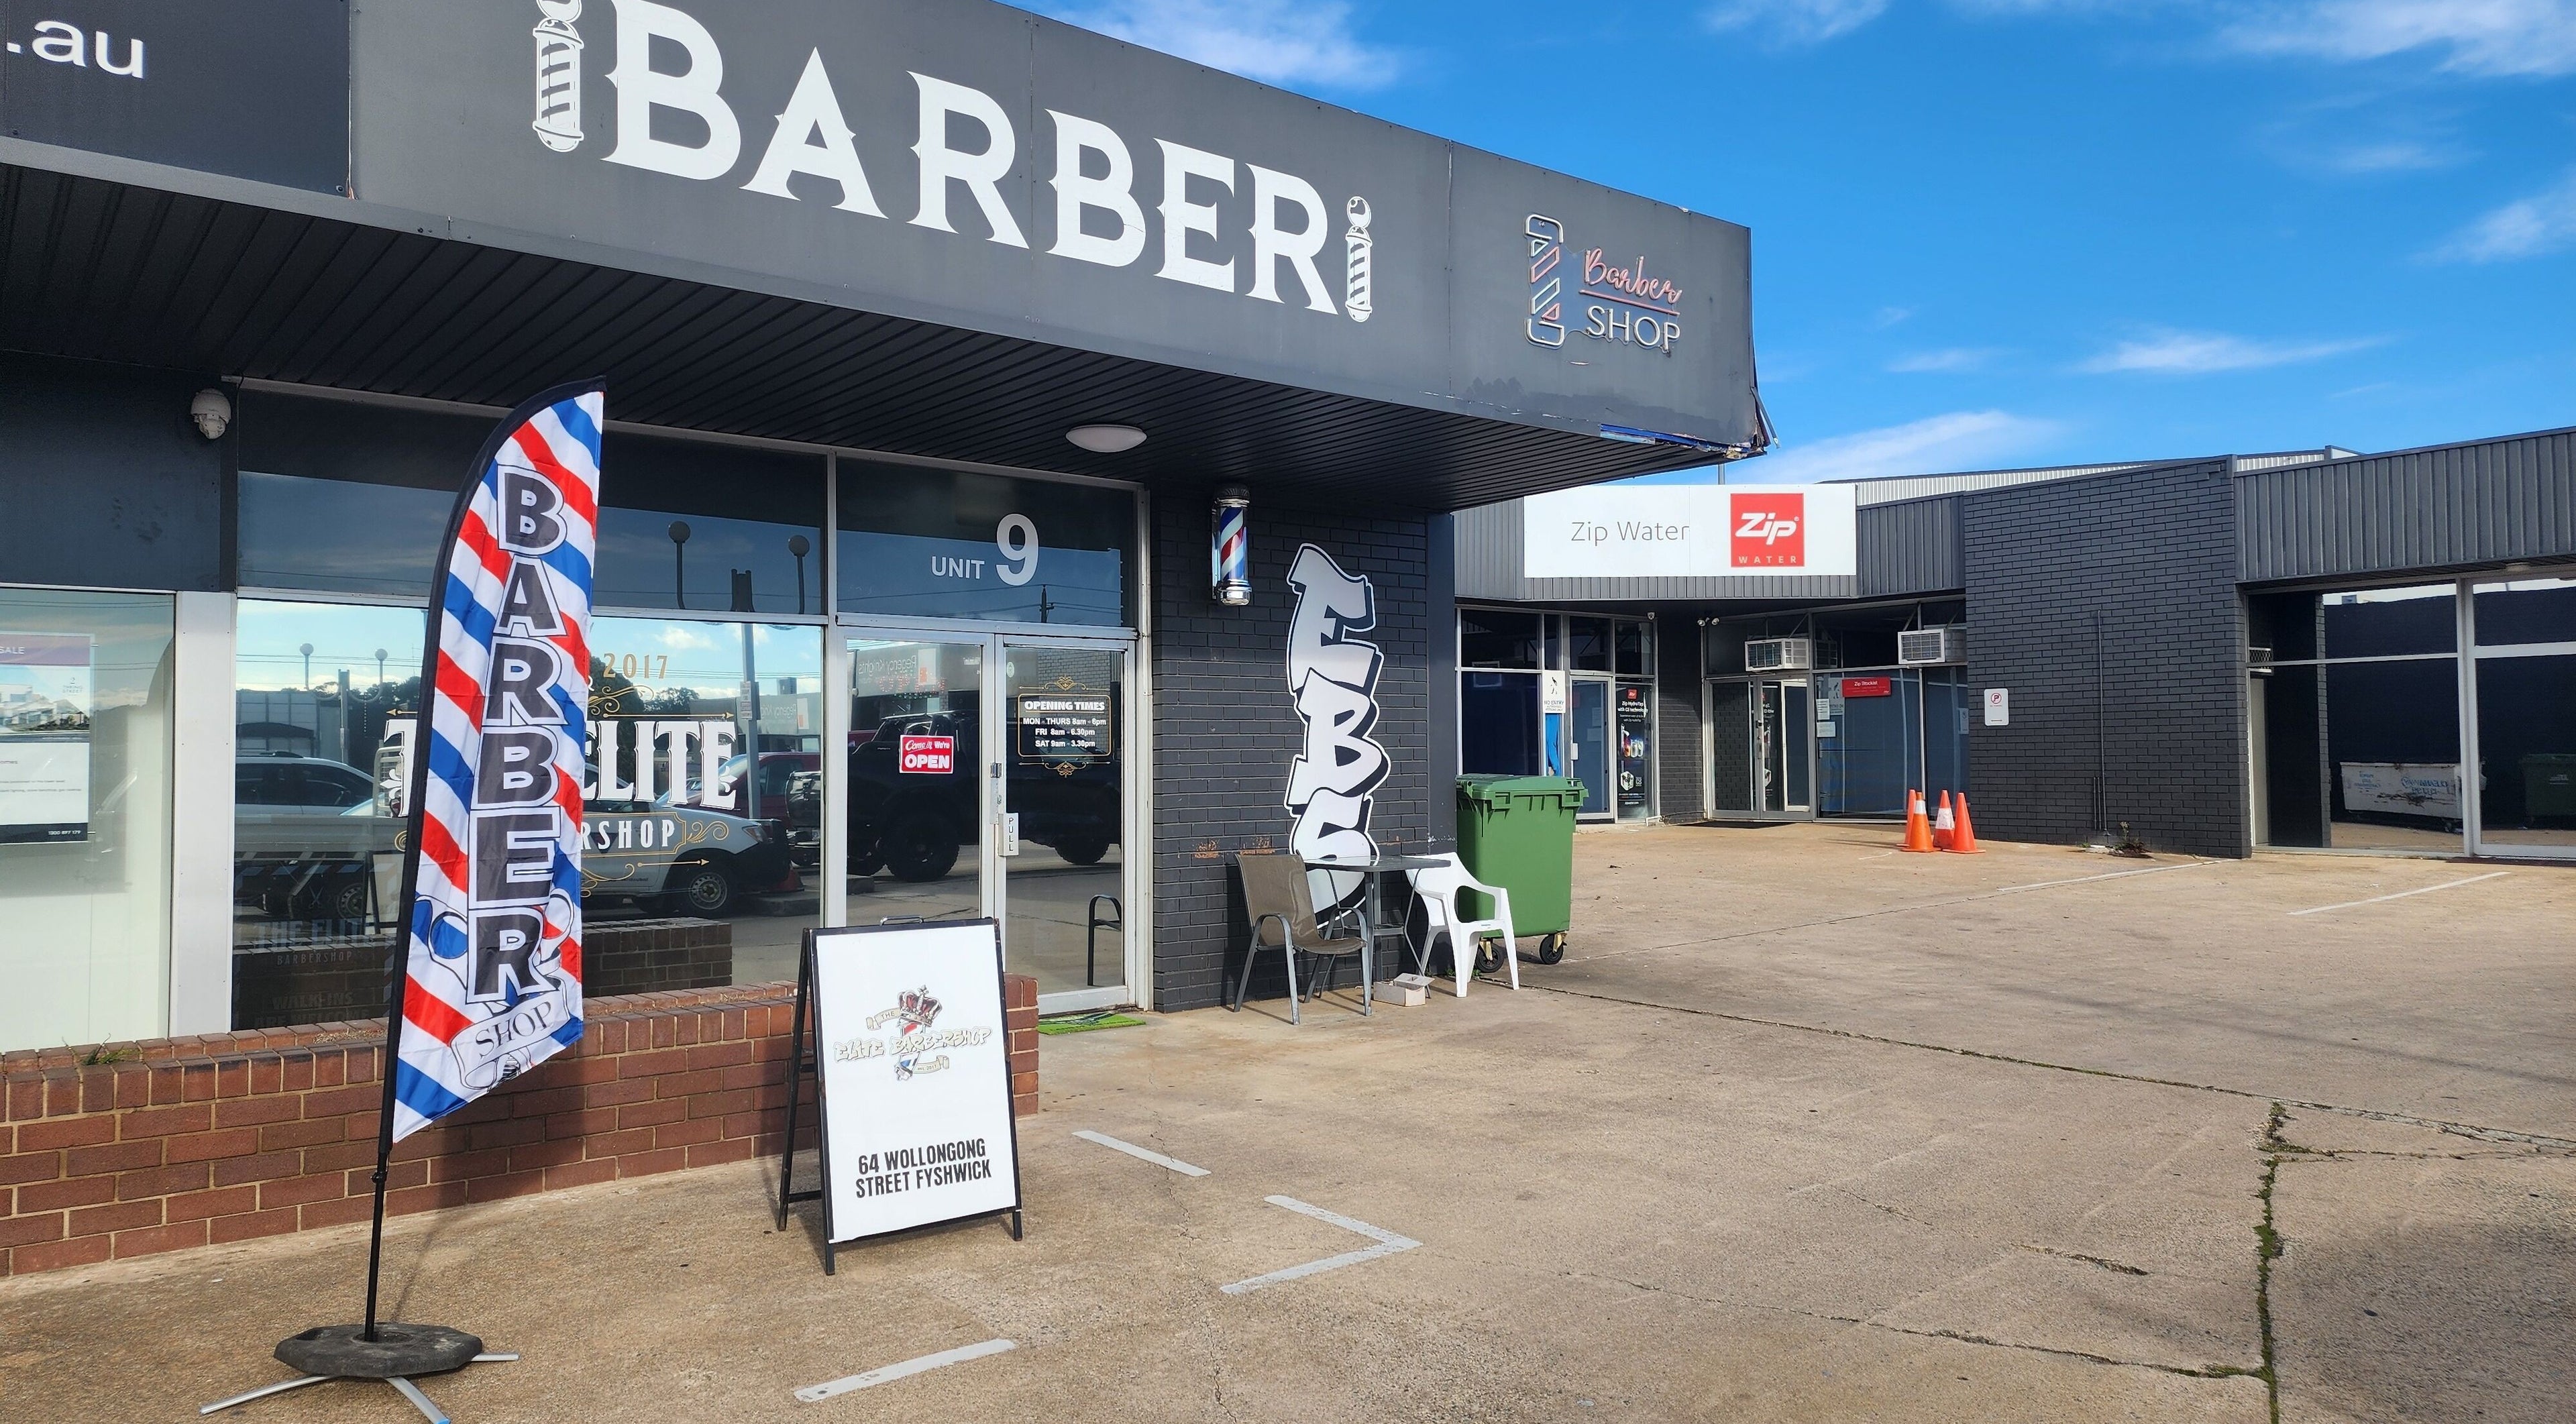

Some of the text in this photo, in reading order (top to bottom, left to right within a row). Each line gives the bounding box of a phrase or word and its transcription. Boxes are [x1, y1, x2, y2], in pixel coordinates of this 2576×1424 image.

[7, 21, 143, 78] .au
[600, 0, 1338, 315] BARBER
[1584, 247, 1683, 304] Barber
[1586, 306, 1680, 353] SHOP
[932, 513, 1038, 586] UNIT 9
[1571, 521, 1690, 547] Zip Water
[1739, 556, 1797, 564] WATER
[604, 653, 667, 679] 2017
[1024, 701, 1105, 711] OPENING TIMES
[466, 465, 568, 1003] BARBER
[906, 740, 925, 751] Come
[905, 754, 950, 769] OPEN
[277, 951, 353, 965] BARBERSHOP
[475, 1001, 551, 1058] SHOP
[881, 1011, 895, 1019] THE
[835, 1028, 992, 1062] ELITE BARBERSHOP
[858, 1138, 986, 1175] 64 WOLLONGONG
[855, 1159, 992, 1199] STREET FYSHWICK
